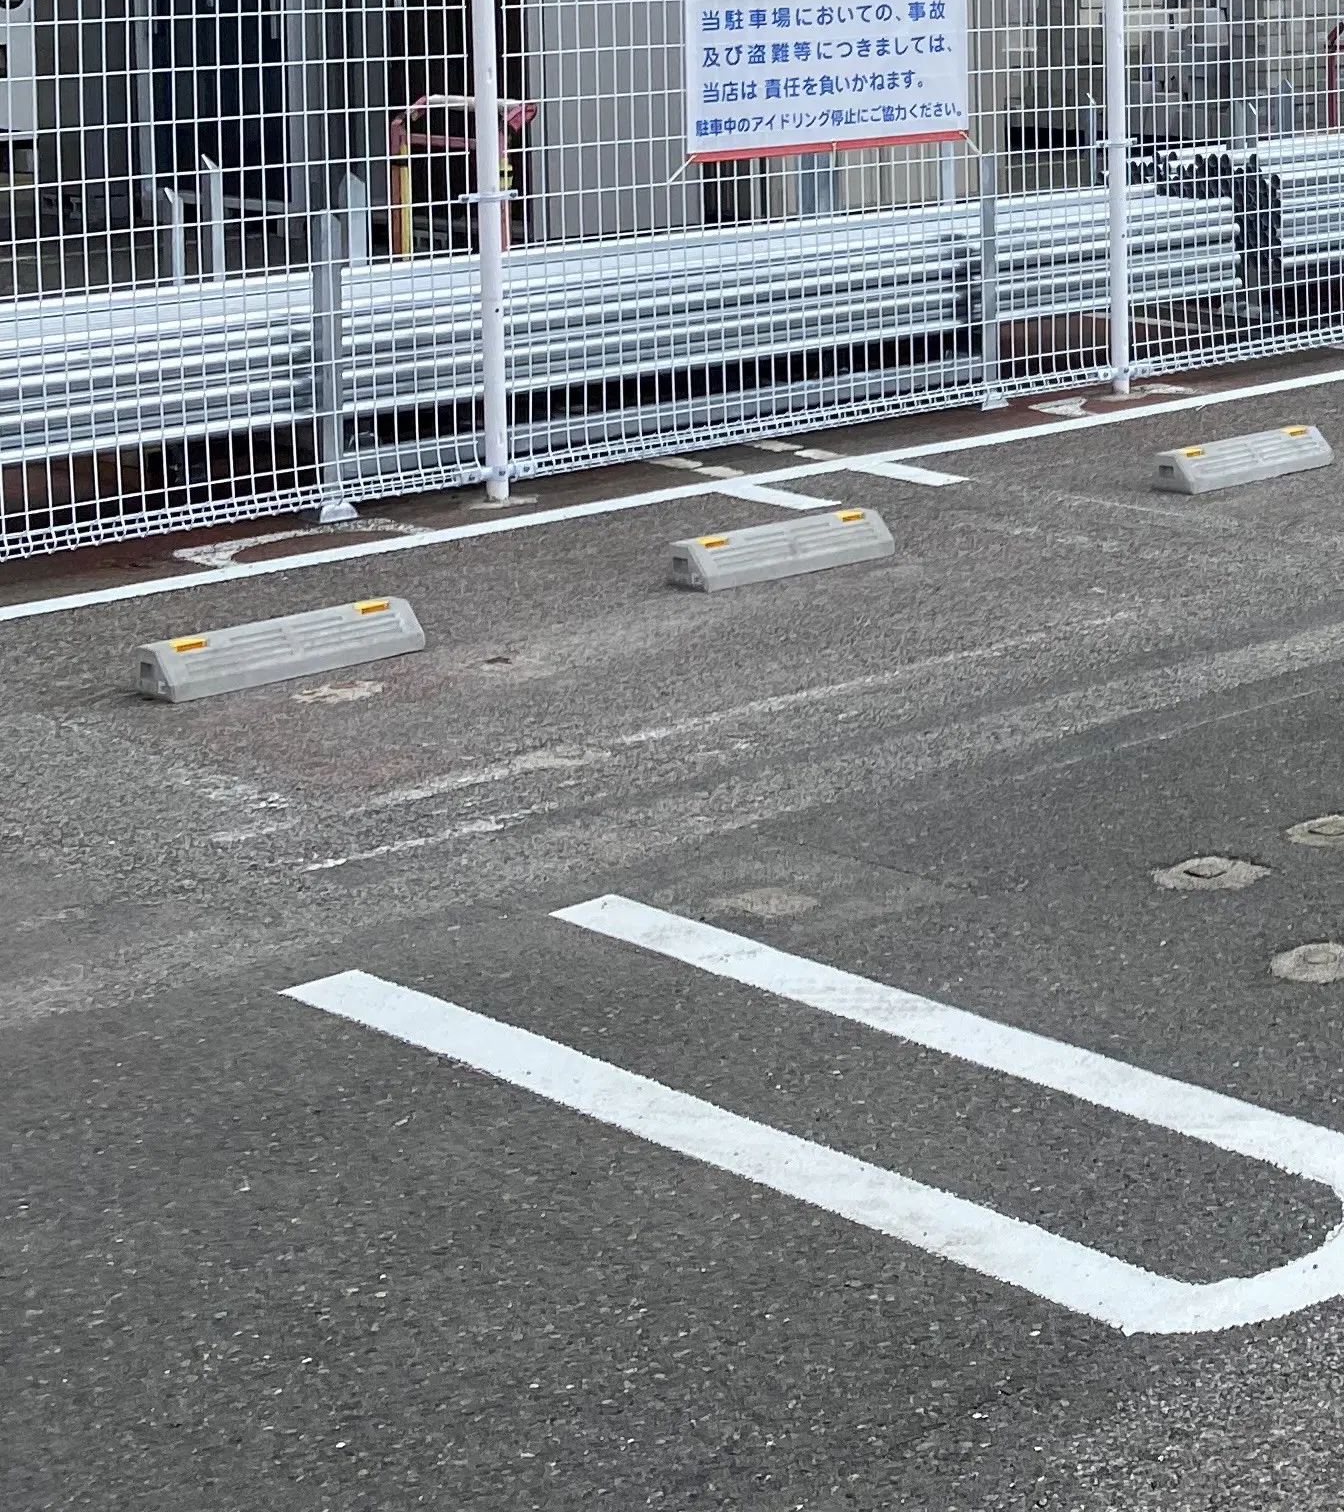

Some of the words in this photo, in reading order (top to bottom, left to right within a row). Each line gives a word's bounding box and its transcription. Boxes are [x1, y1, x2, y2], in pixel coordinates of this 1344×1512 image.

[701, 0, 946, 32] 当駐車場においての、事故
[702, 35, 953, 68] 及び盗難等につきましては、
[695, 102, 962, 137] 駐車中のアイドリング停止にご協力ください。
